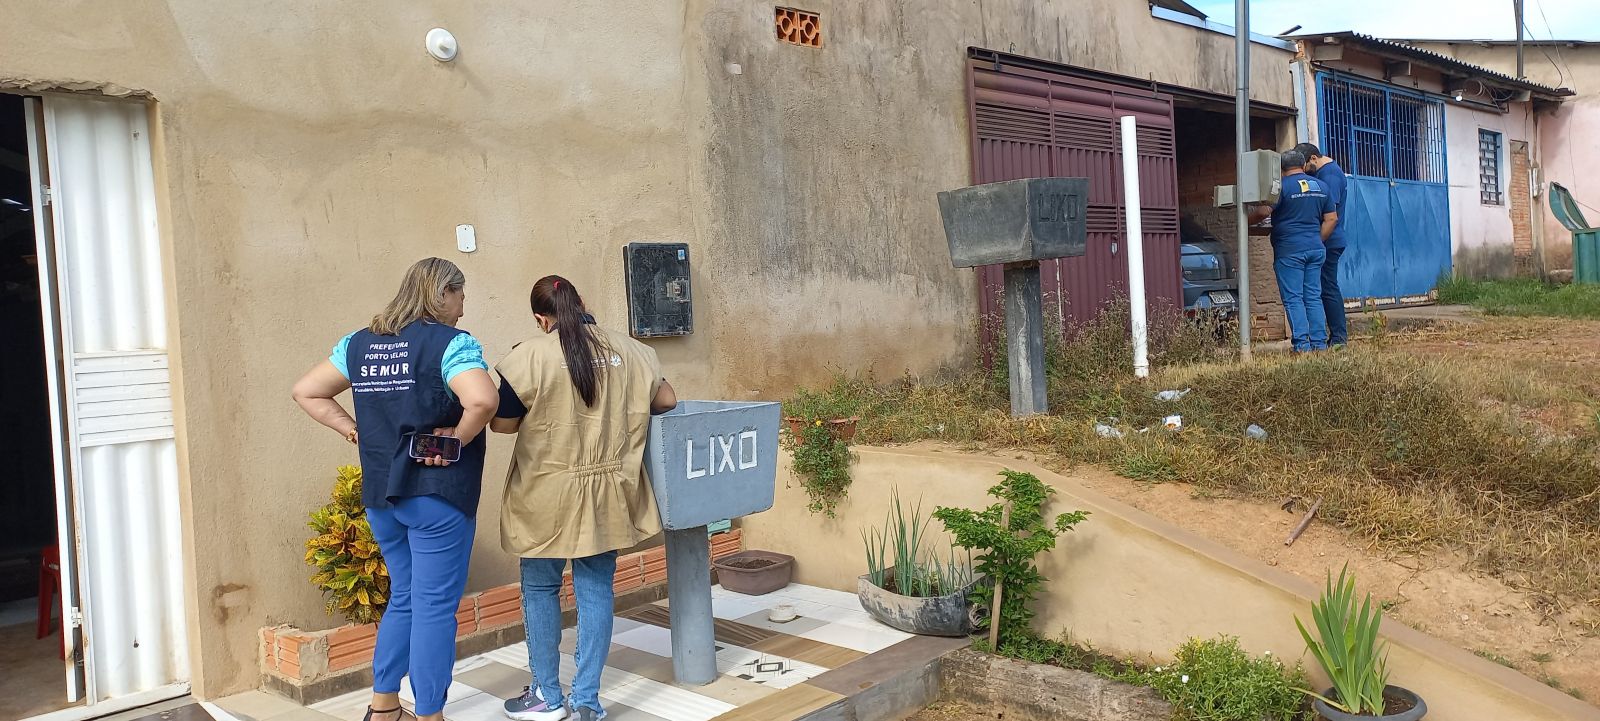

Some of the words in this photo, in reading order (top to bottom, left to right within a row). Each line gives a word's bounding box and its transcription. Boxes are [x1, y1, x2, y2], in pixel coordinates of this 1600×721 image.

[1038, 193, 1079, 223] LIXO
[369, 341, 409, 350] PREFEITURA
[360, 362, 410, 377] SEMUR
[686, 430, 758, 480] LIXO
